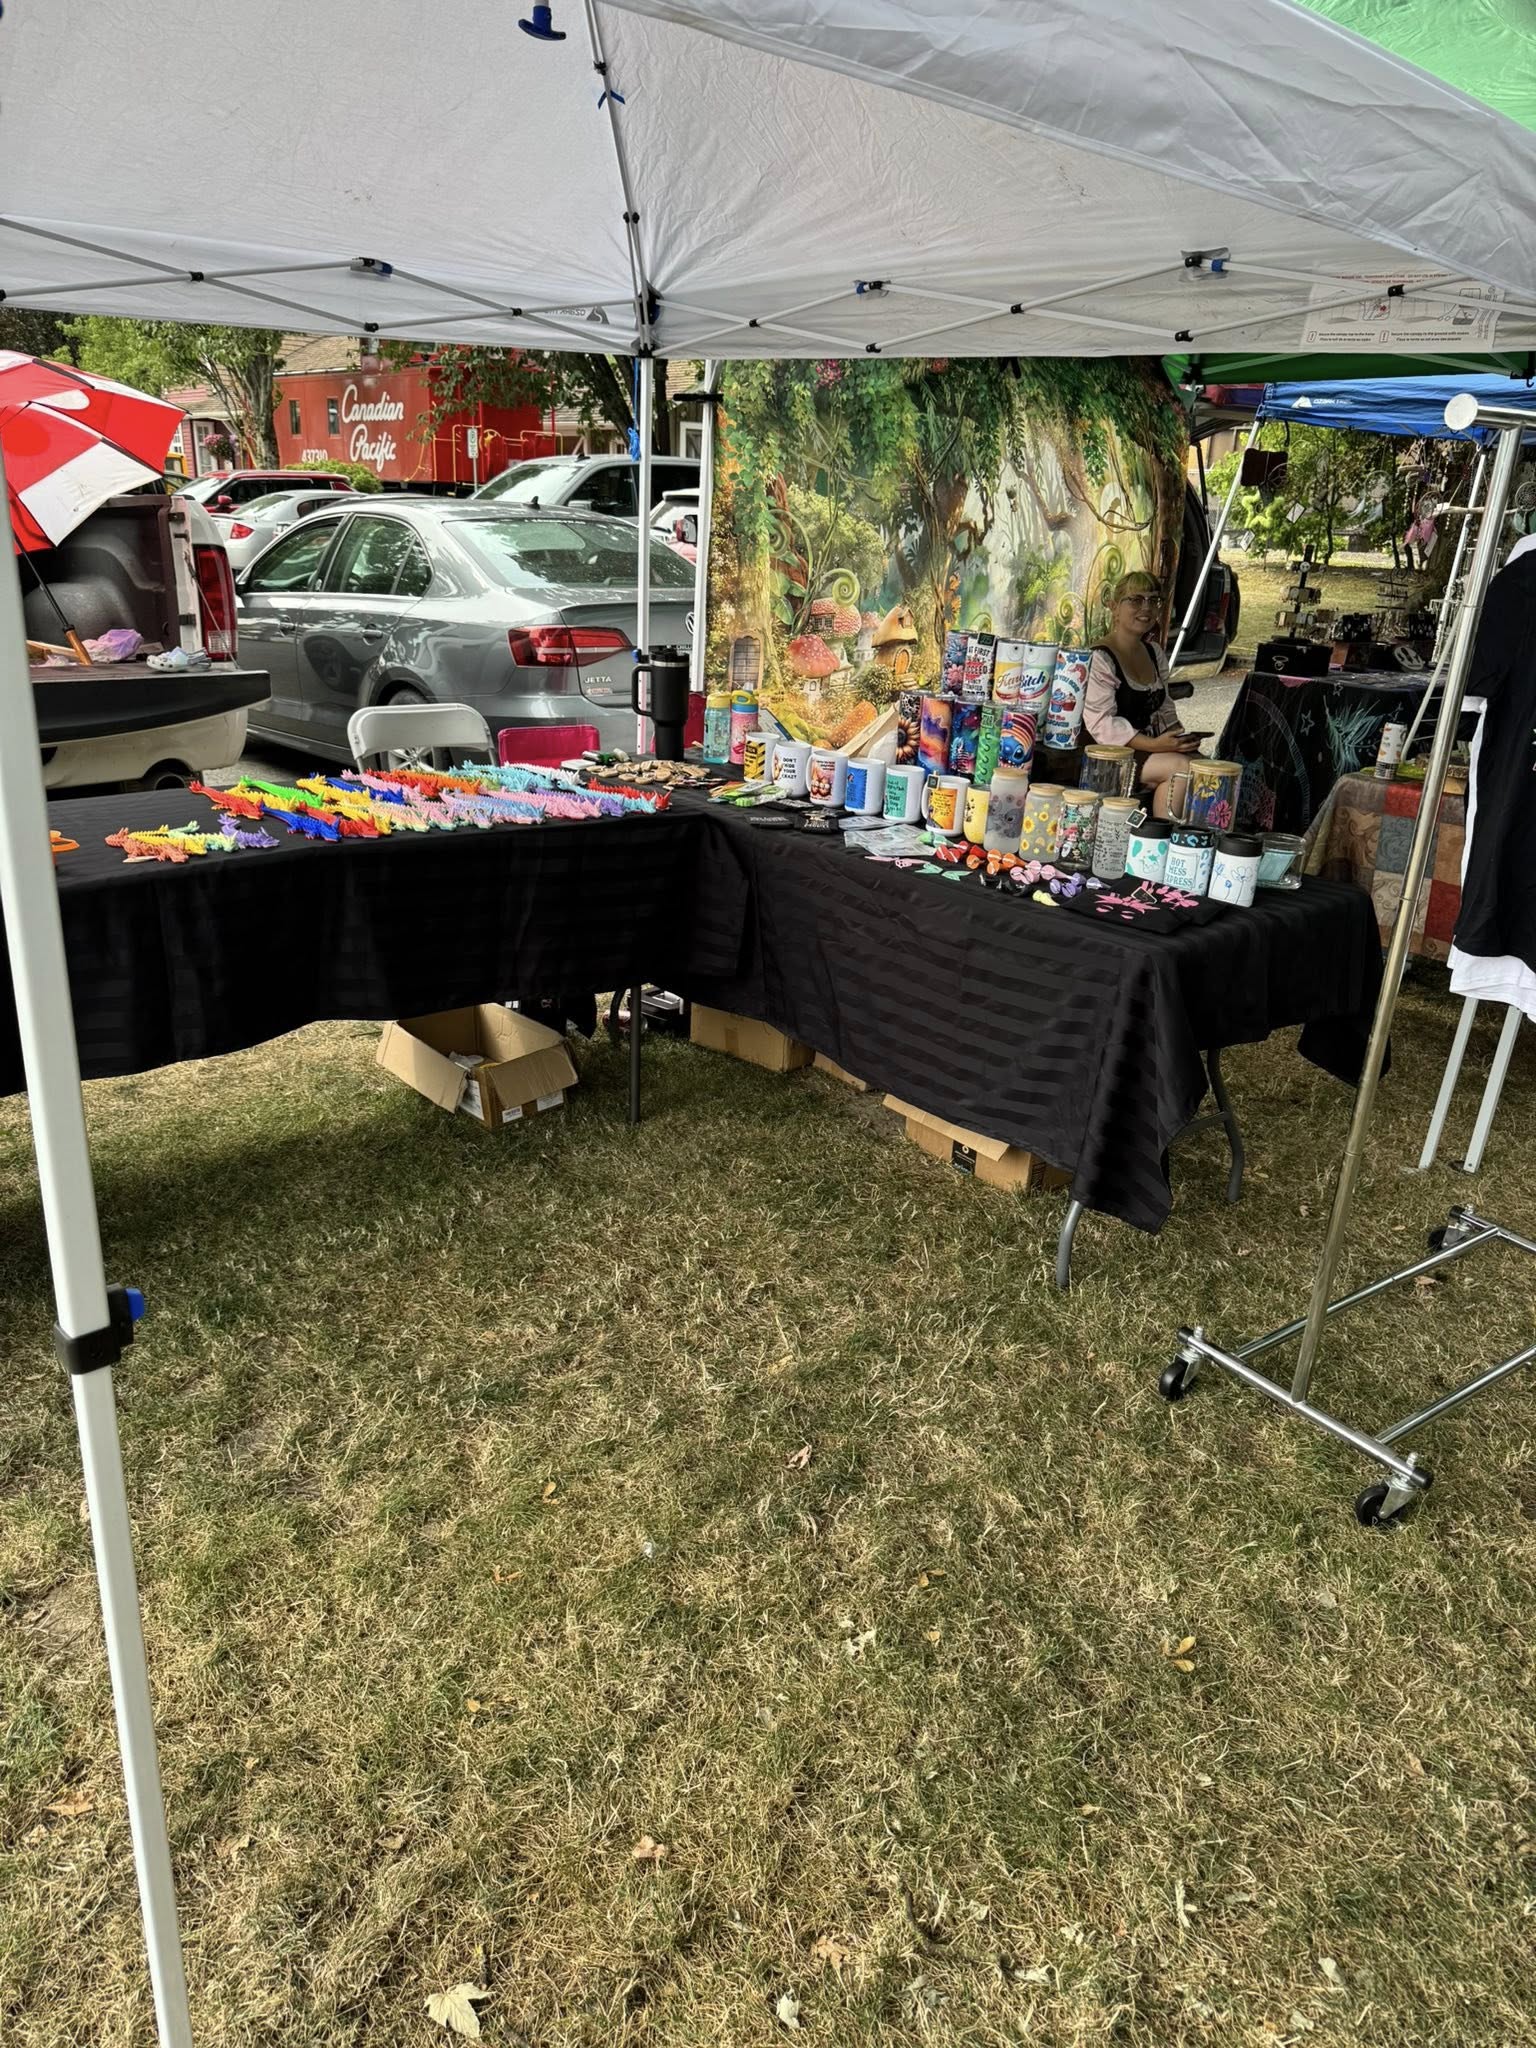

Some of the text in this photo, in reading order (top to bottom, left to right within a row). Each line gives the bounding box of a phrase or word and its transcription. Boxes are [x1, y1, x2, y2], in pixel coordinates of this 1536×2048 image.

[341, 384, 405, 424] Canadian
[350, 424, 397, 472] Pacific
[585, 676, 612, 684] JETTA
[1019, 671, 1046, 688] Bitch
[1171, 857, 1186, 868] HOT
[1168, 865, 1187, 876] MESS
[1165, 873, 1193, 887] XPRESS
